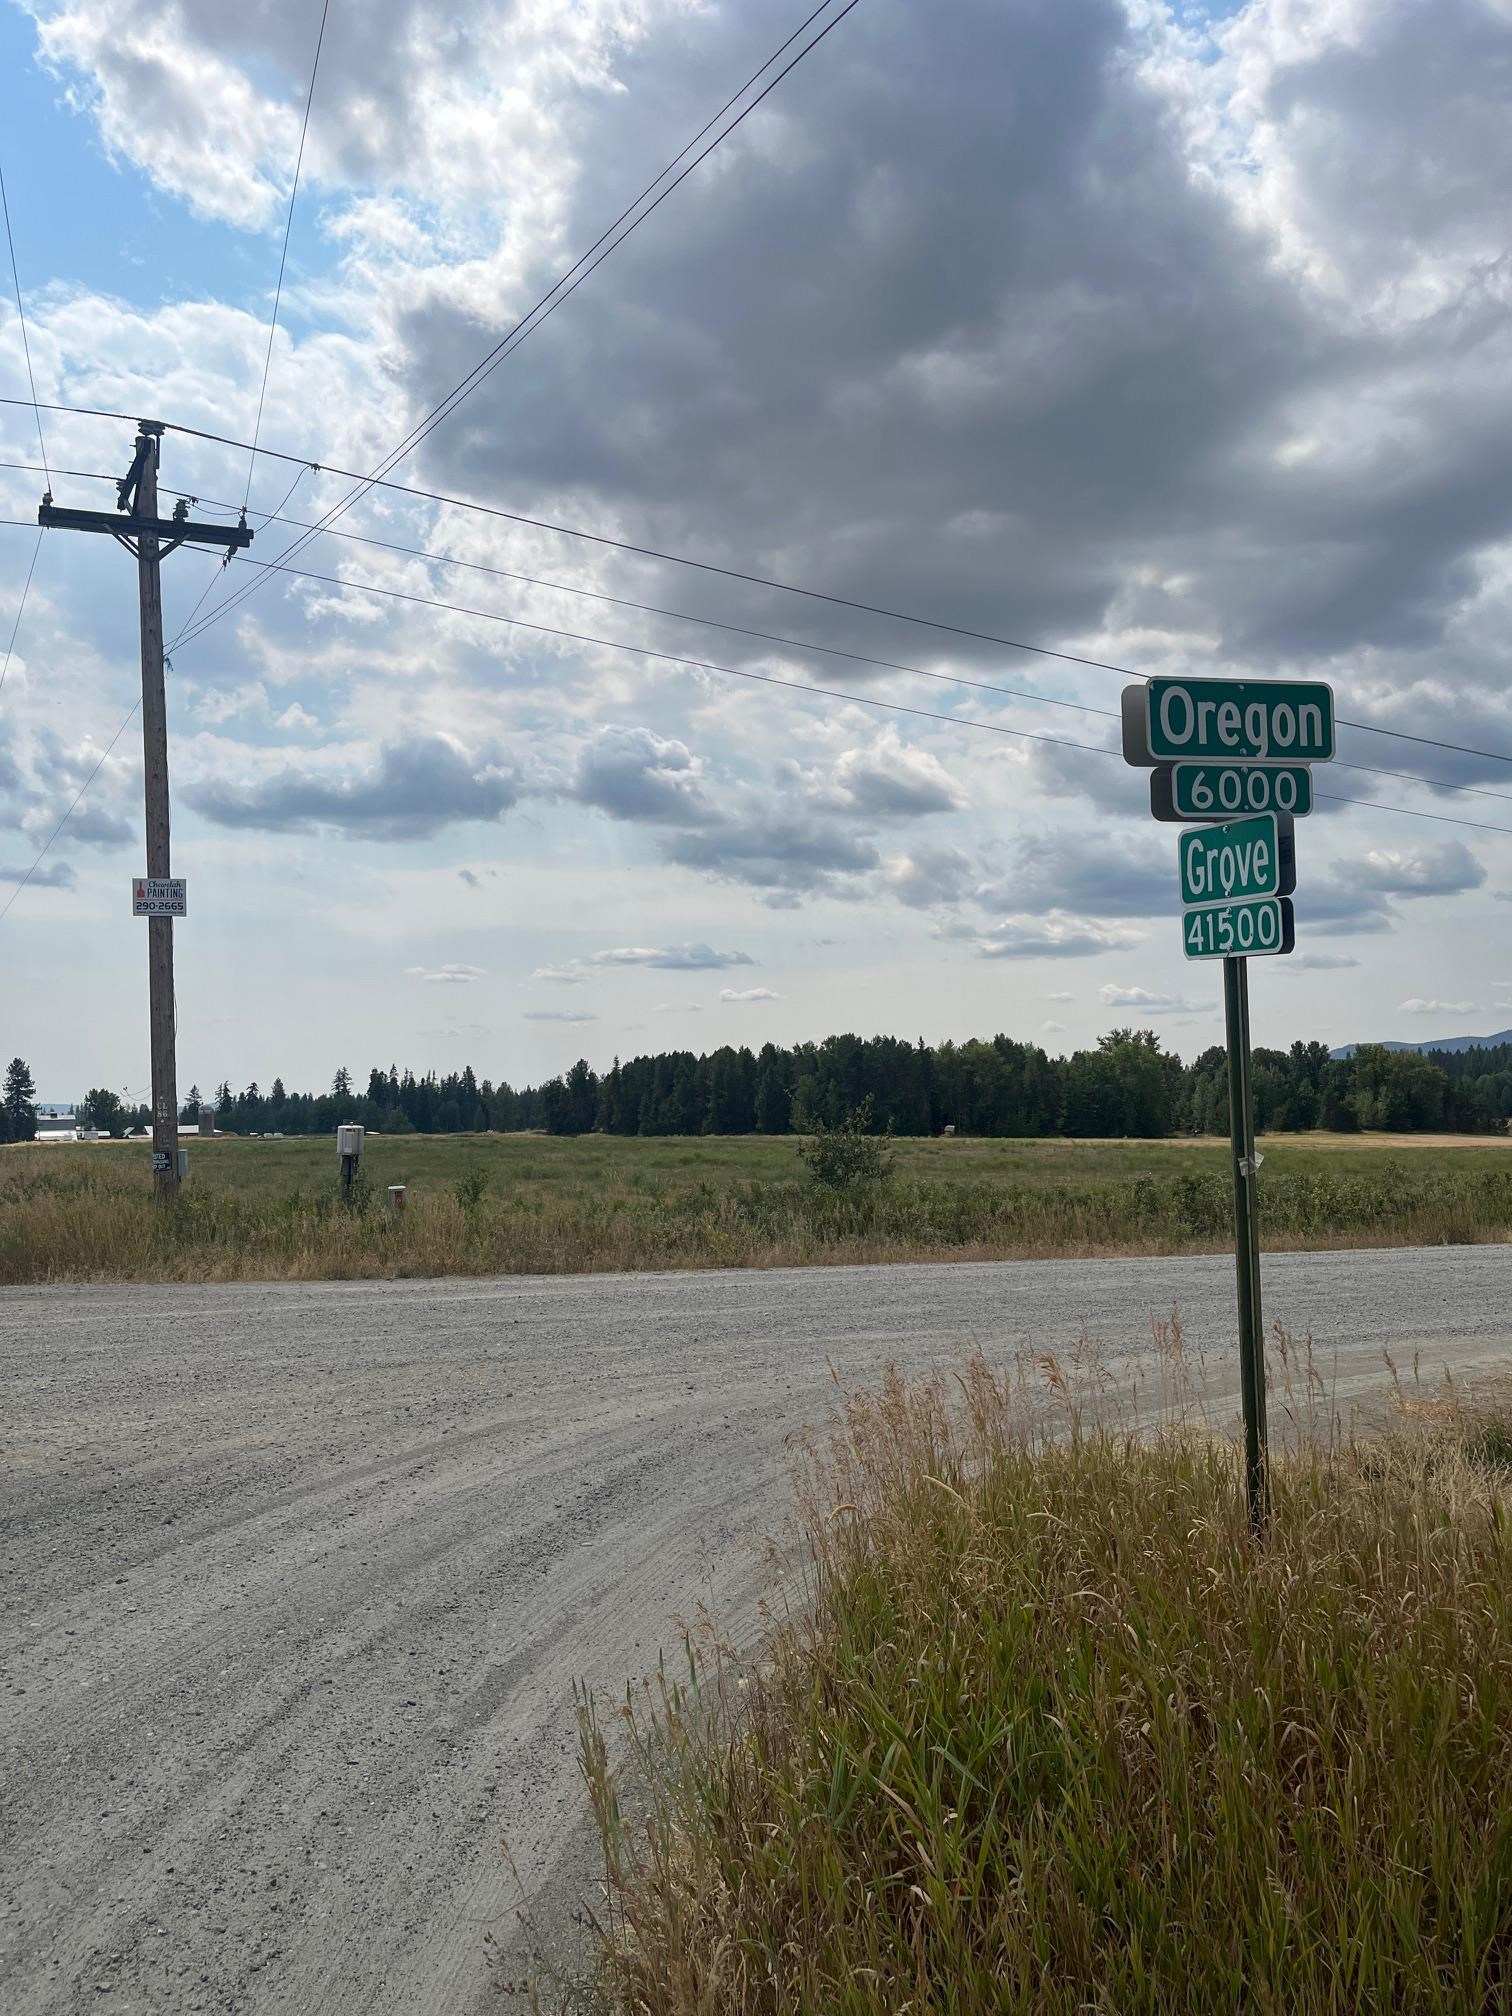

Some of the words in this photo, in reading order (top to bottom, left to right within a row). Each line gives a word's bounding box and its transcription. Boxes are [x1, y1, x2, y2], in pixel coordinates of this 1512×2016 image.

[1160, 685, 1323, 760] Oregon
[1191, 770, 1297, 810] 6000
[1187, 838, 1269, 895] Grove
[136, 902, 184, 910] 290-2665
[147, 888, 183, 898] PAINTING
[1188, 904, 1276, 952] 41500
